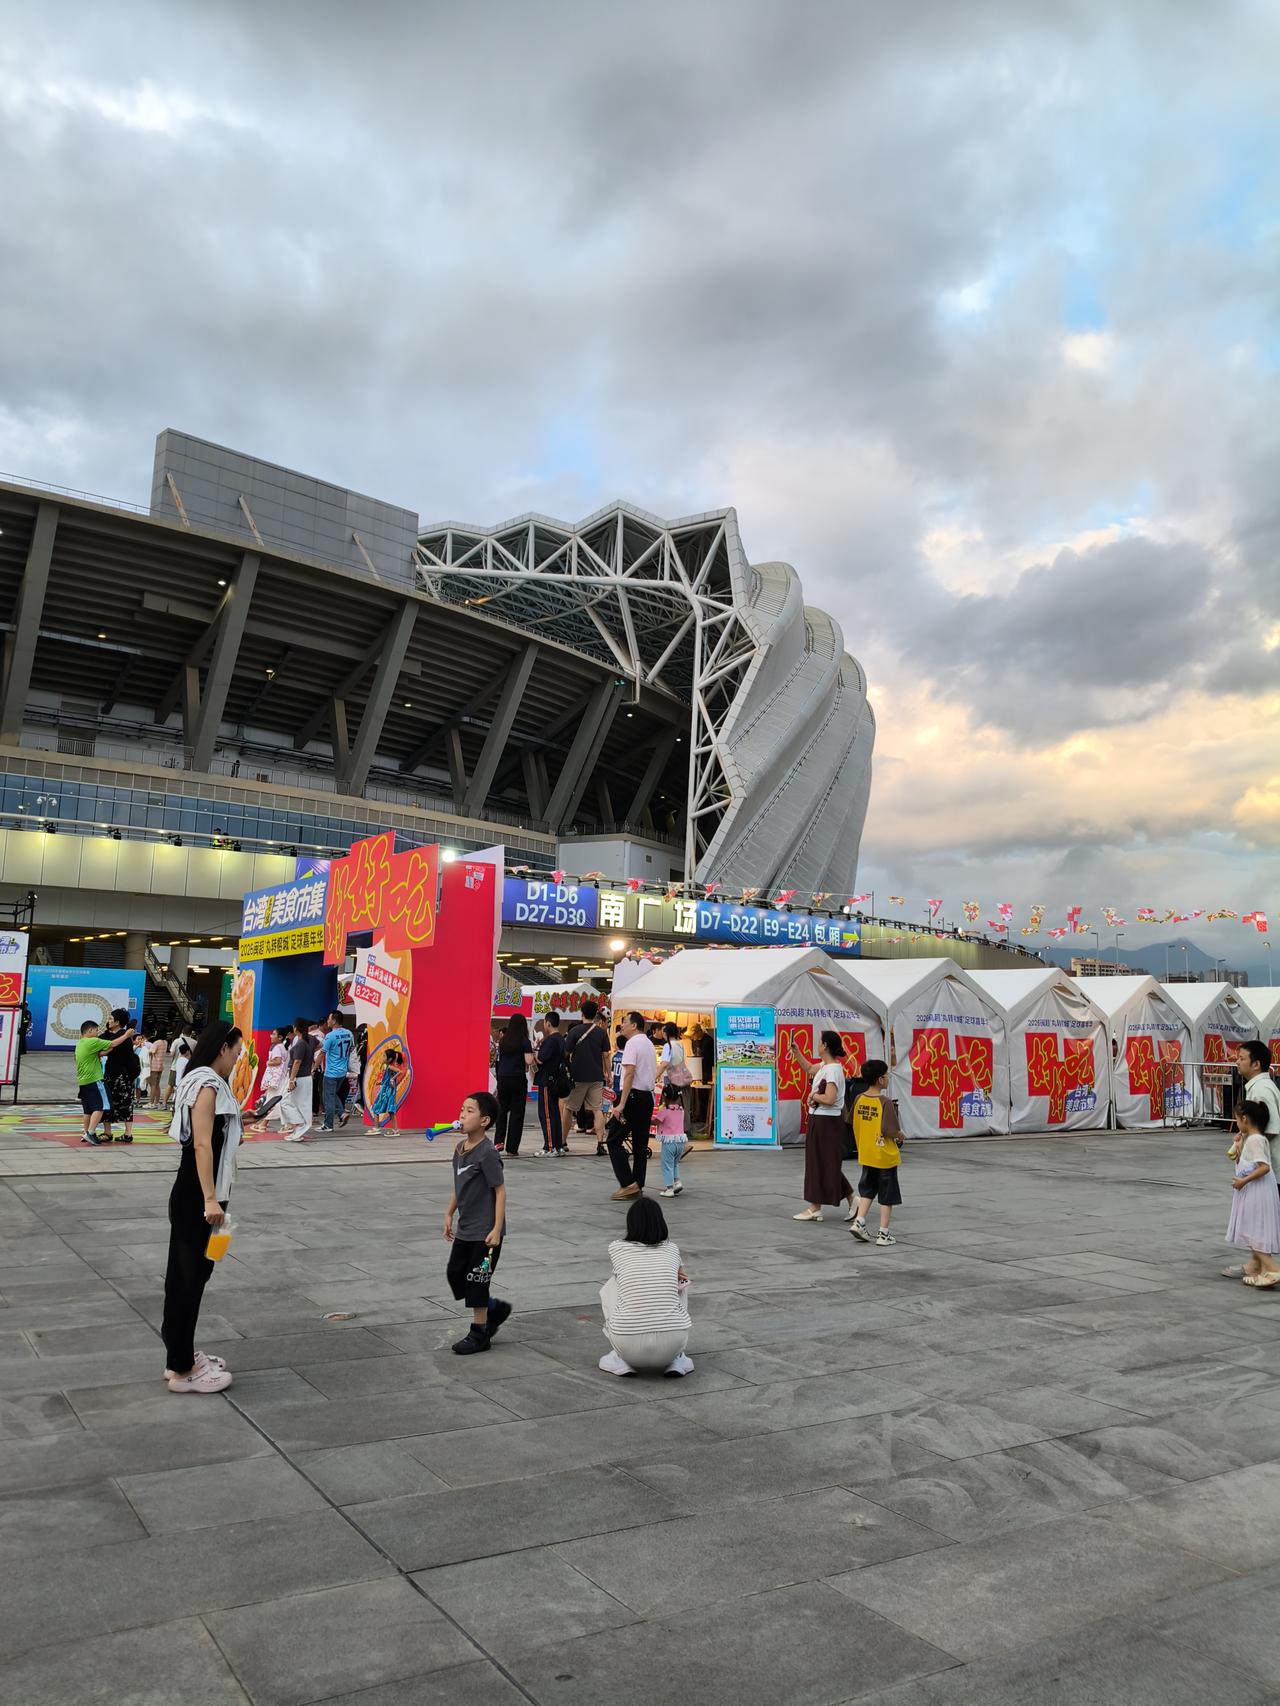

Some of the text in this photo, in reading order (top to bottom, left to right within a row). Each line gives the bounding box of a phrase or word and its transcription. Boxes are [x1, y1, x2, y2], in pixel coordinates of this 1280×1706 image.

[527, 882, 578, 905] D1-D6
[516, 903, 586, 926] D27-D30
[600, 893, 697, 933] 南广场
[701, 910, 840, 947] D7-D22 E9-E24 包厢
[337, 1040, 350, 1058] 17
